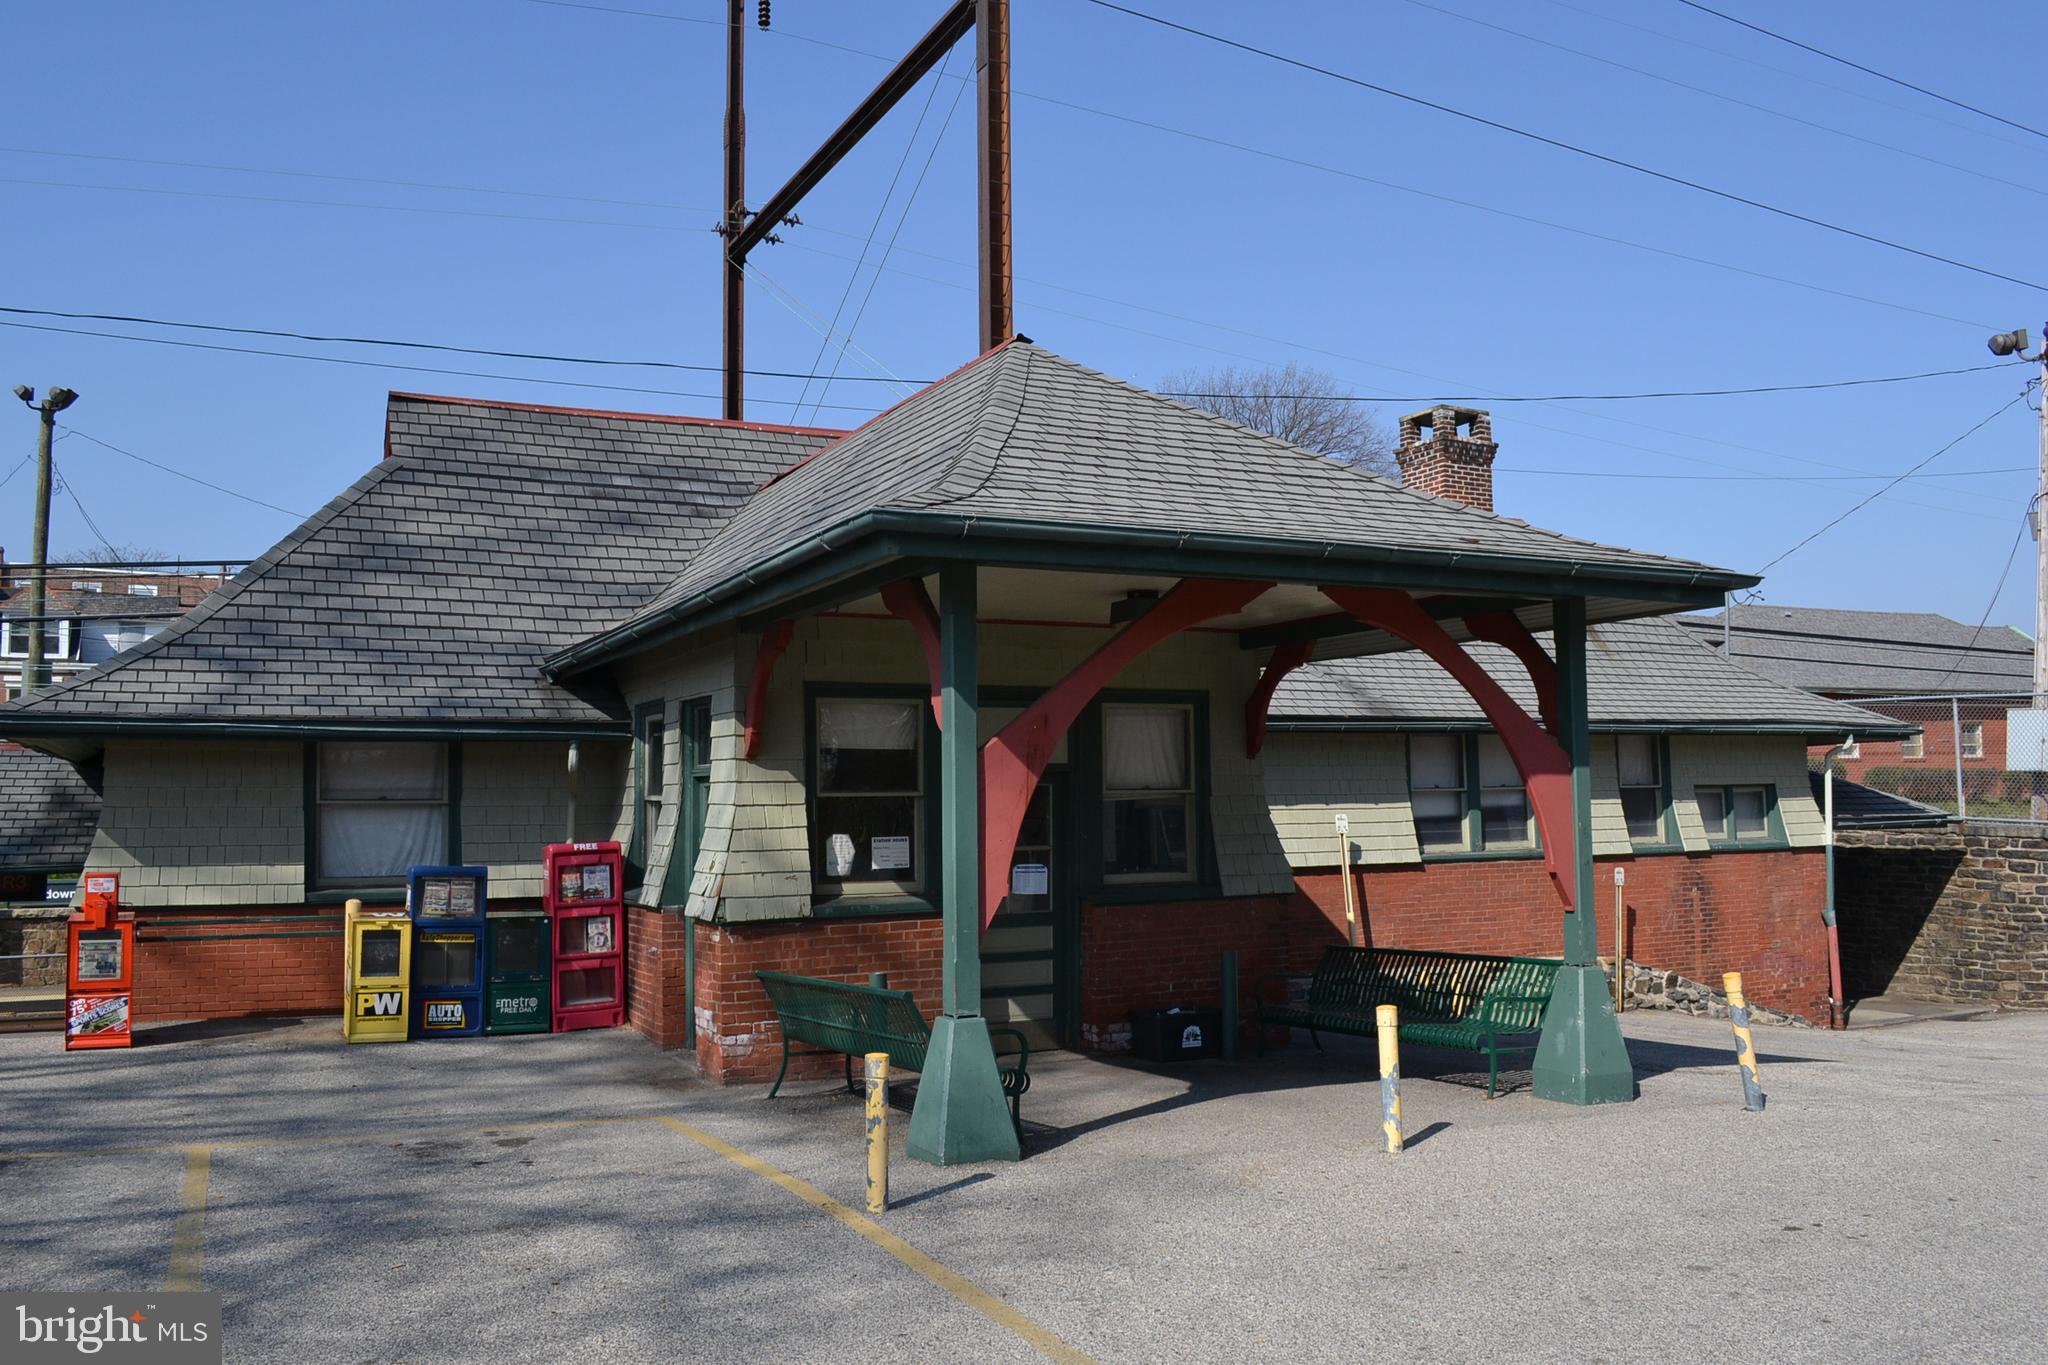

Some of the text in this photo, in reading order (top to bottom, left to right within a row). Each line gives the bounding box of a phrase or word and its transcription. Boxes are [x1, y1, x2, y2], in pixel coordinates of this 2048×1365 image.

[574, 843, 599, 851] FREE
[357, 993, 401, 1016] PW
[428, 1004, 462, 1017] AUTO
